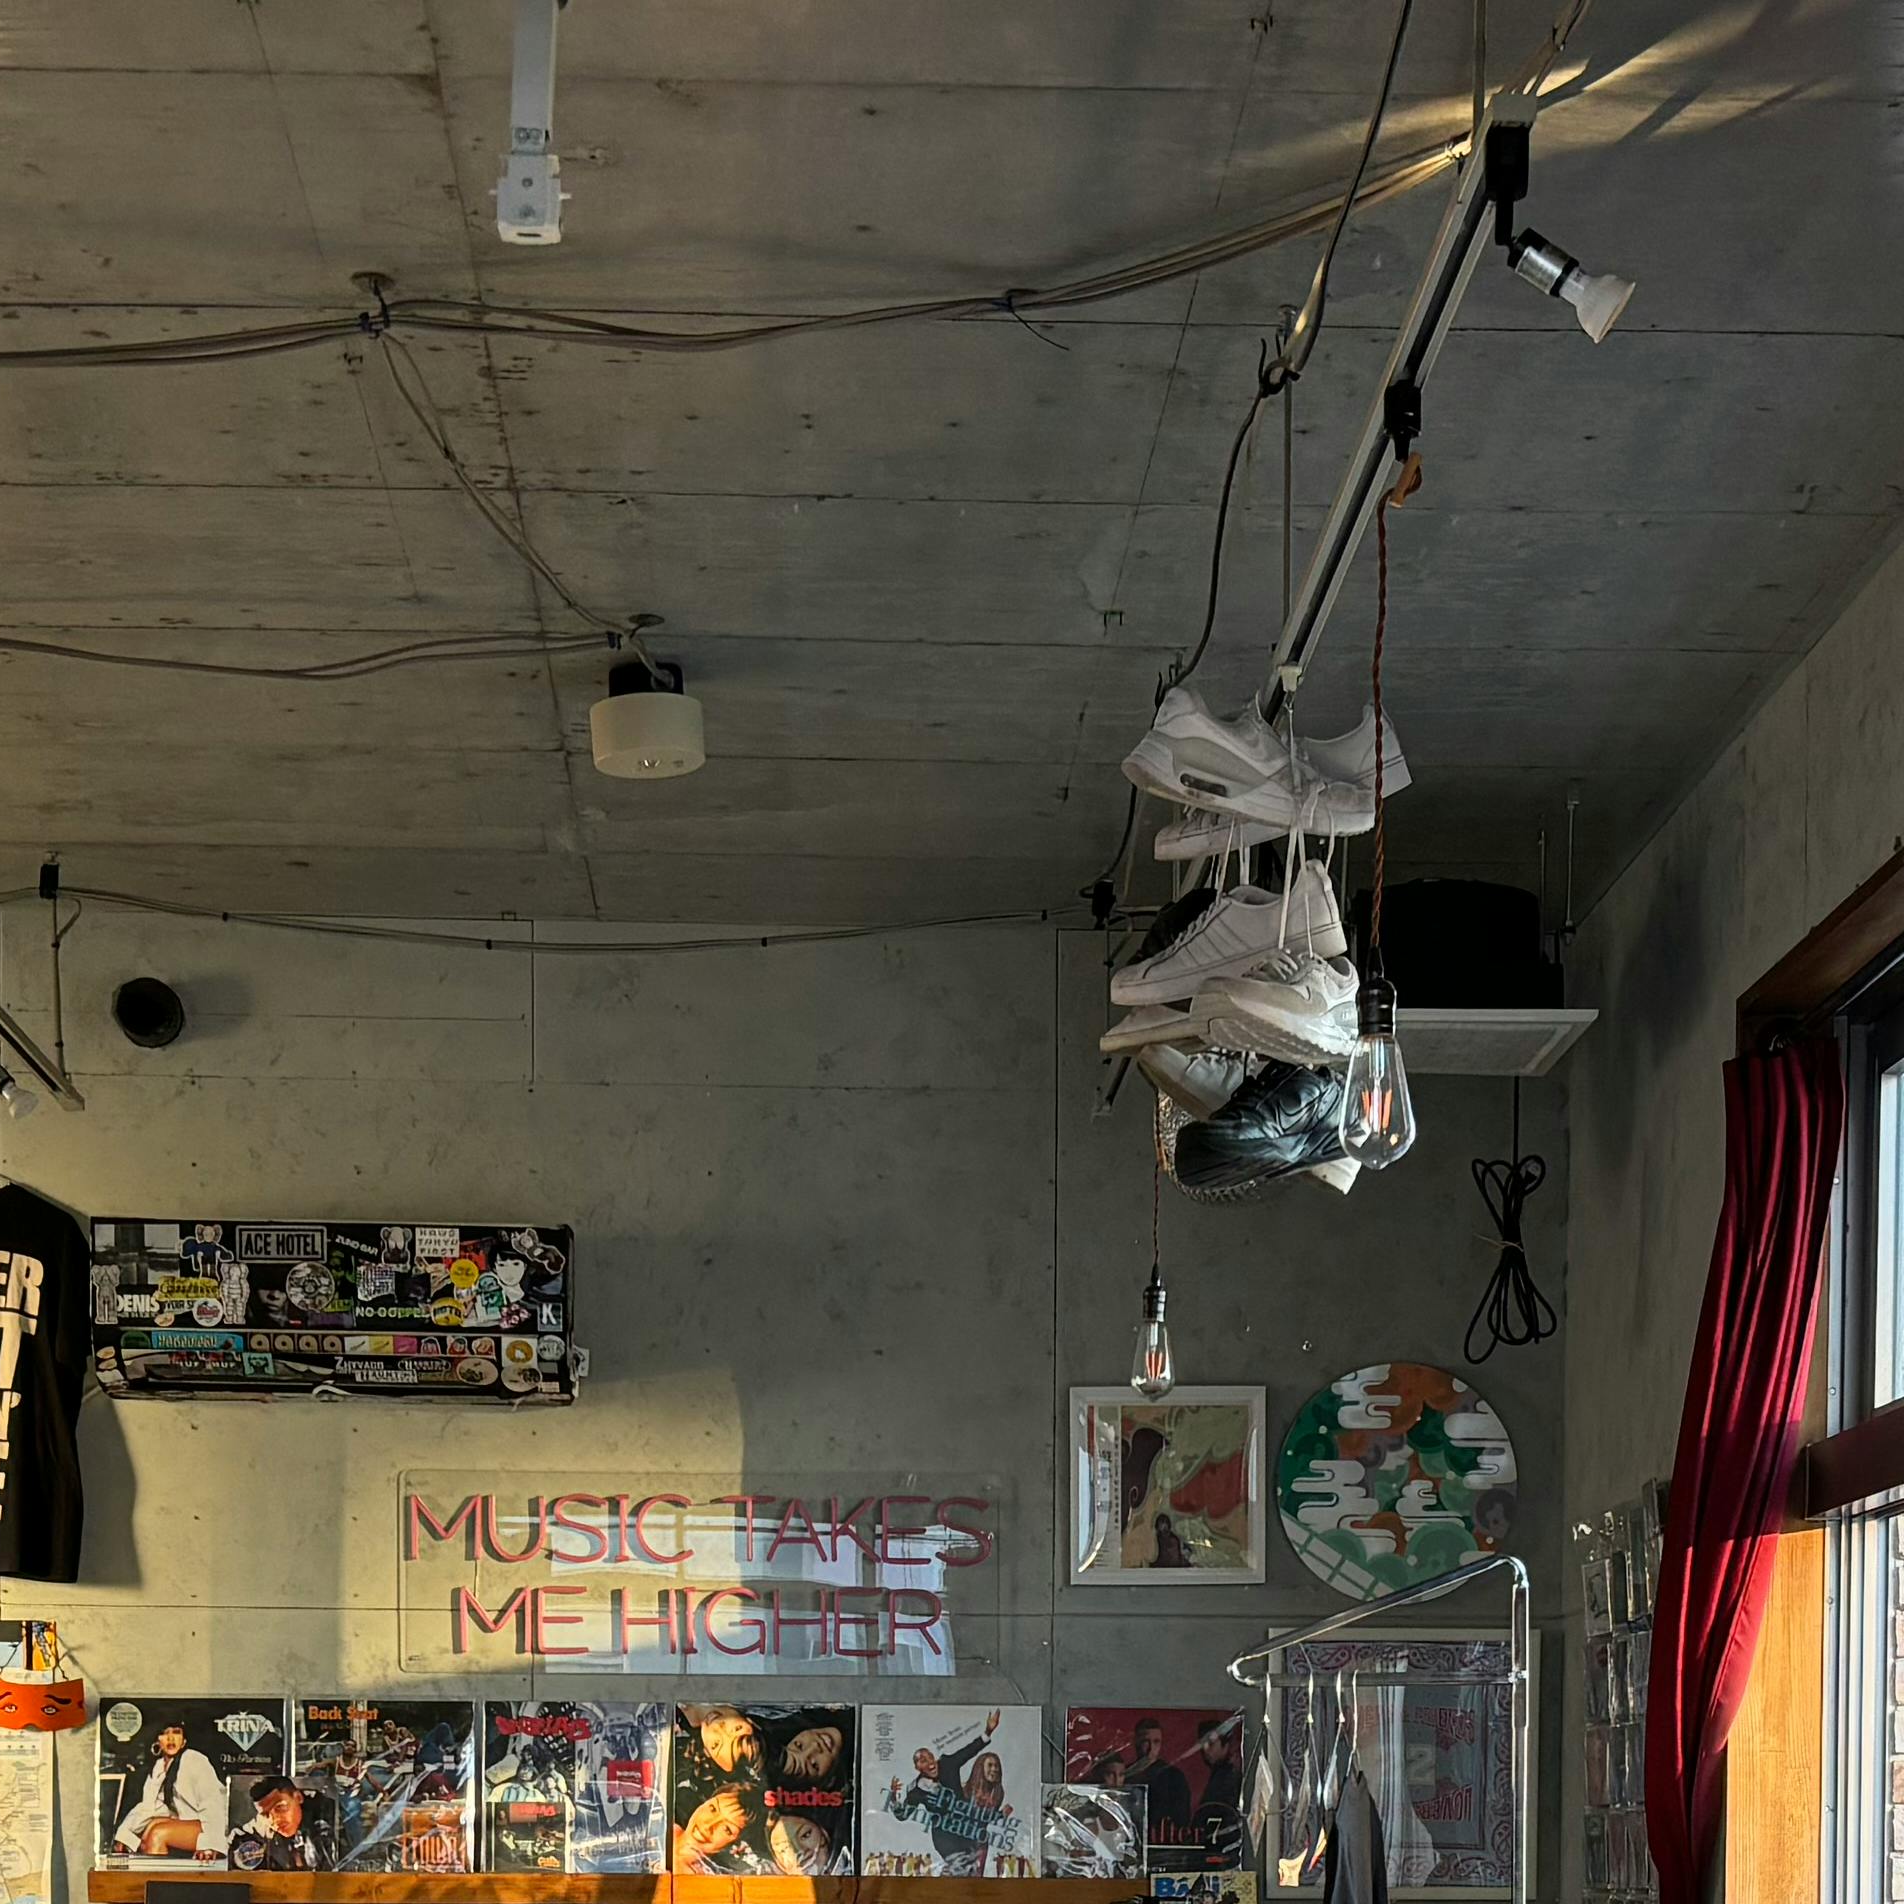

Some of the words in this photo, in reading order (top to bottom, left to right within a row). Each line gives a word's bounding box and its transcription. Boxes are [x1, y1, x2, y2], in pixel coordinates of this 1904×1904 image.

[244, 1233, 273, 1257] ACE
[277, 1233, 320, 1257] HOTEL
[408, 1493, 695, 1564] MUSIC
[710, 1494, 995, 1567] TAKES
[458, 1585, 589, 1656] ME
[620, 1586, 943, 1657] HIGHER
[308, 1705, 342, 1720] Back
[214, 1718, 276, 1733] TRINA
[764, 1787, 843, 1807] shades
[1206, 1817, 1223, 1845] 7
